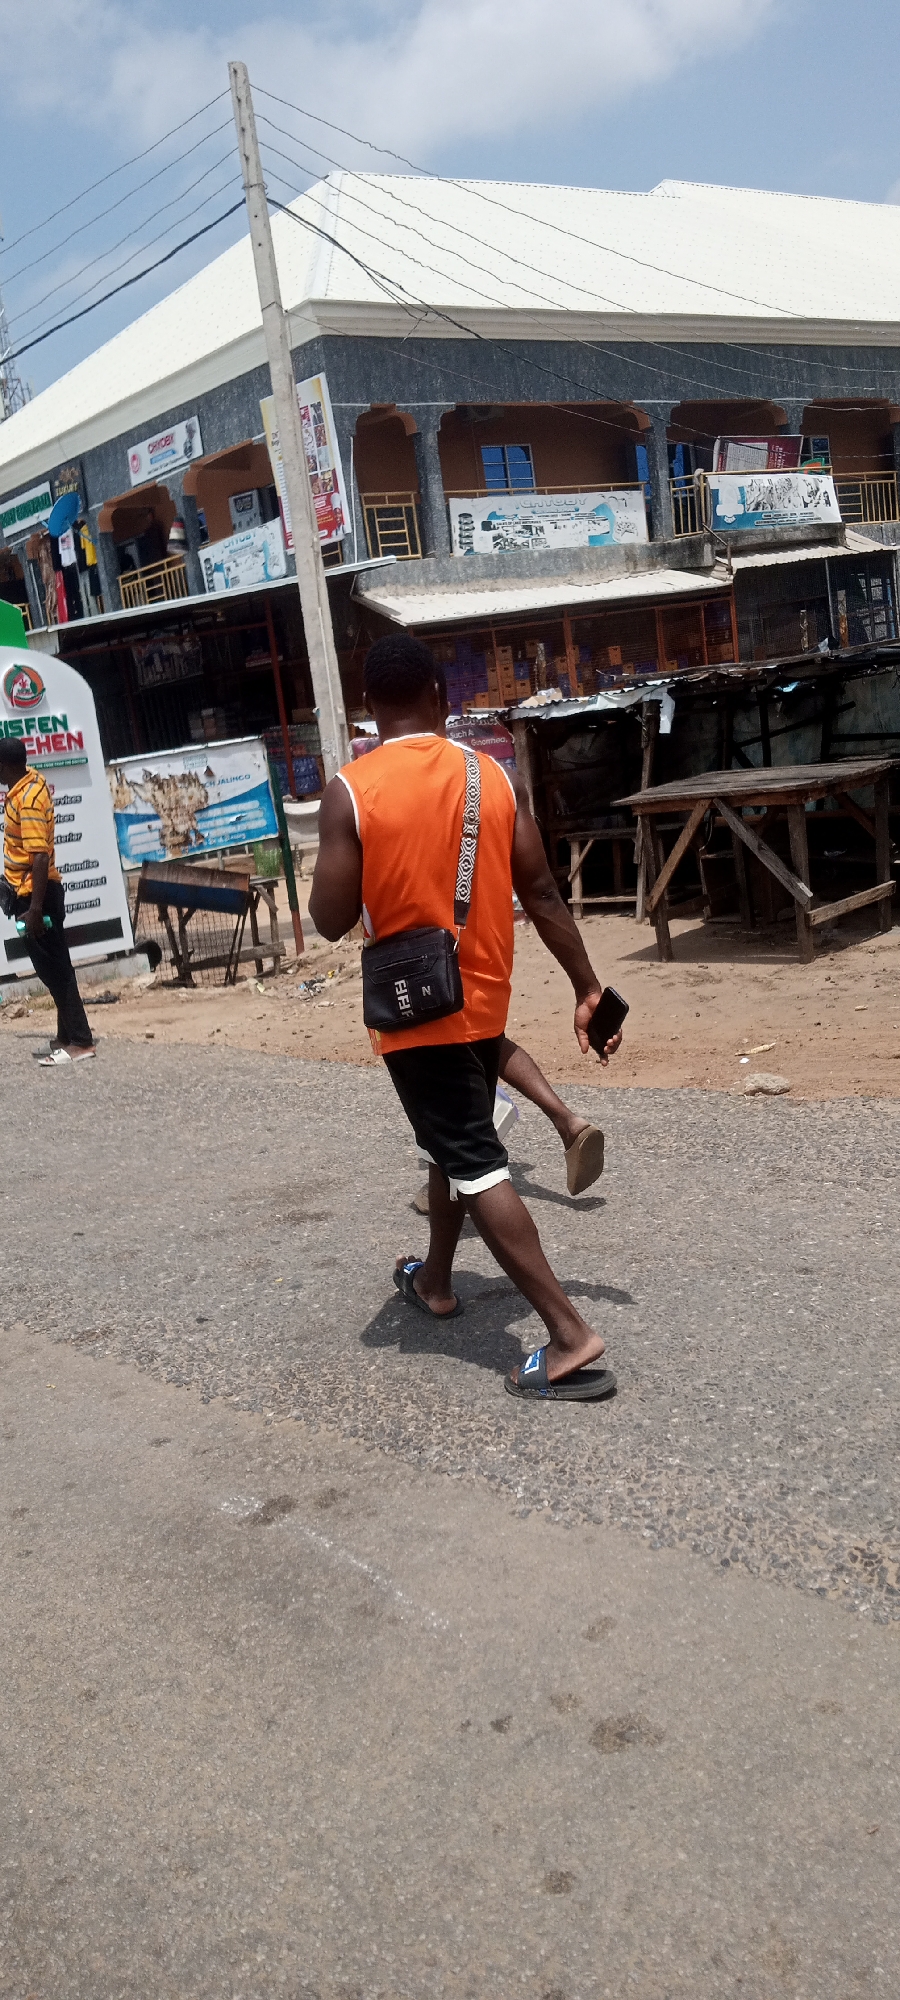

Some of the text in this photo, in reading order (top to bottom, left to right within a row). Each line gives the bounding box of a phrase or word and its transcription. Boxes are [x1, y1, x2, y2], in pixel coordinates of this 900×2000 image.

[20, 731, 84, 755] CHEN
[53, 795, 82, 807] ervices
[56, 859, 99, 873] rchandise
[68, 876, 107, 891] Contract
